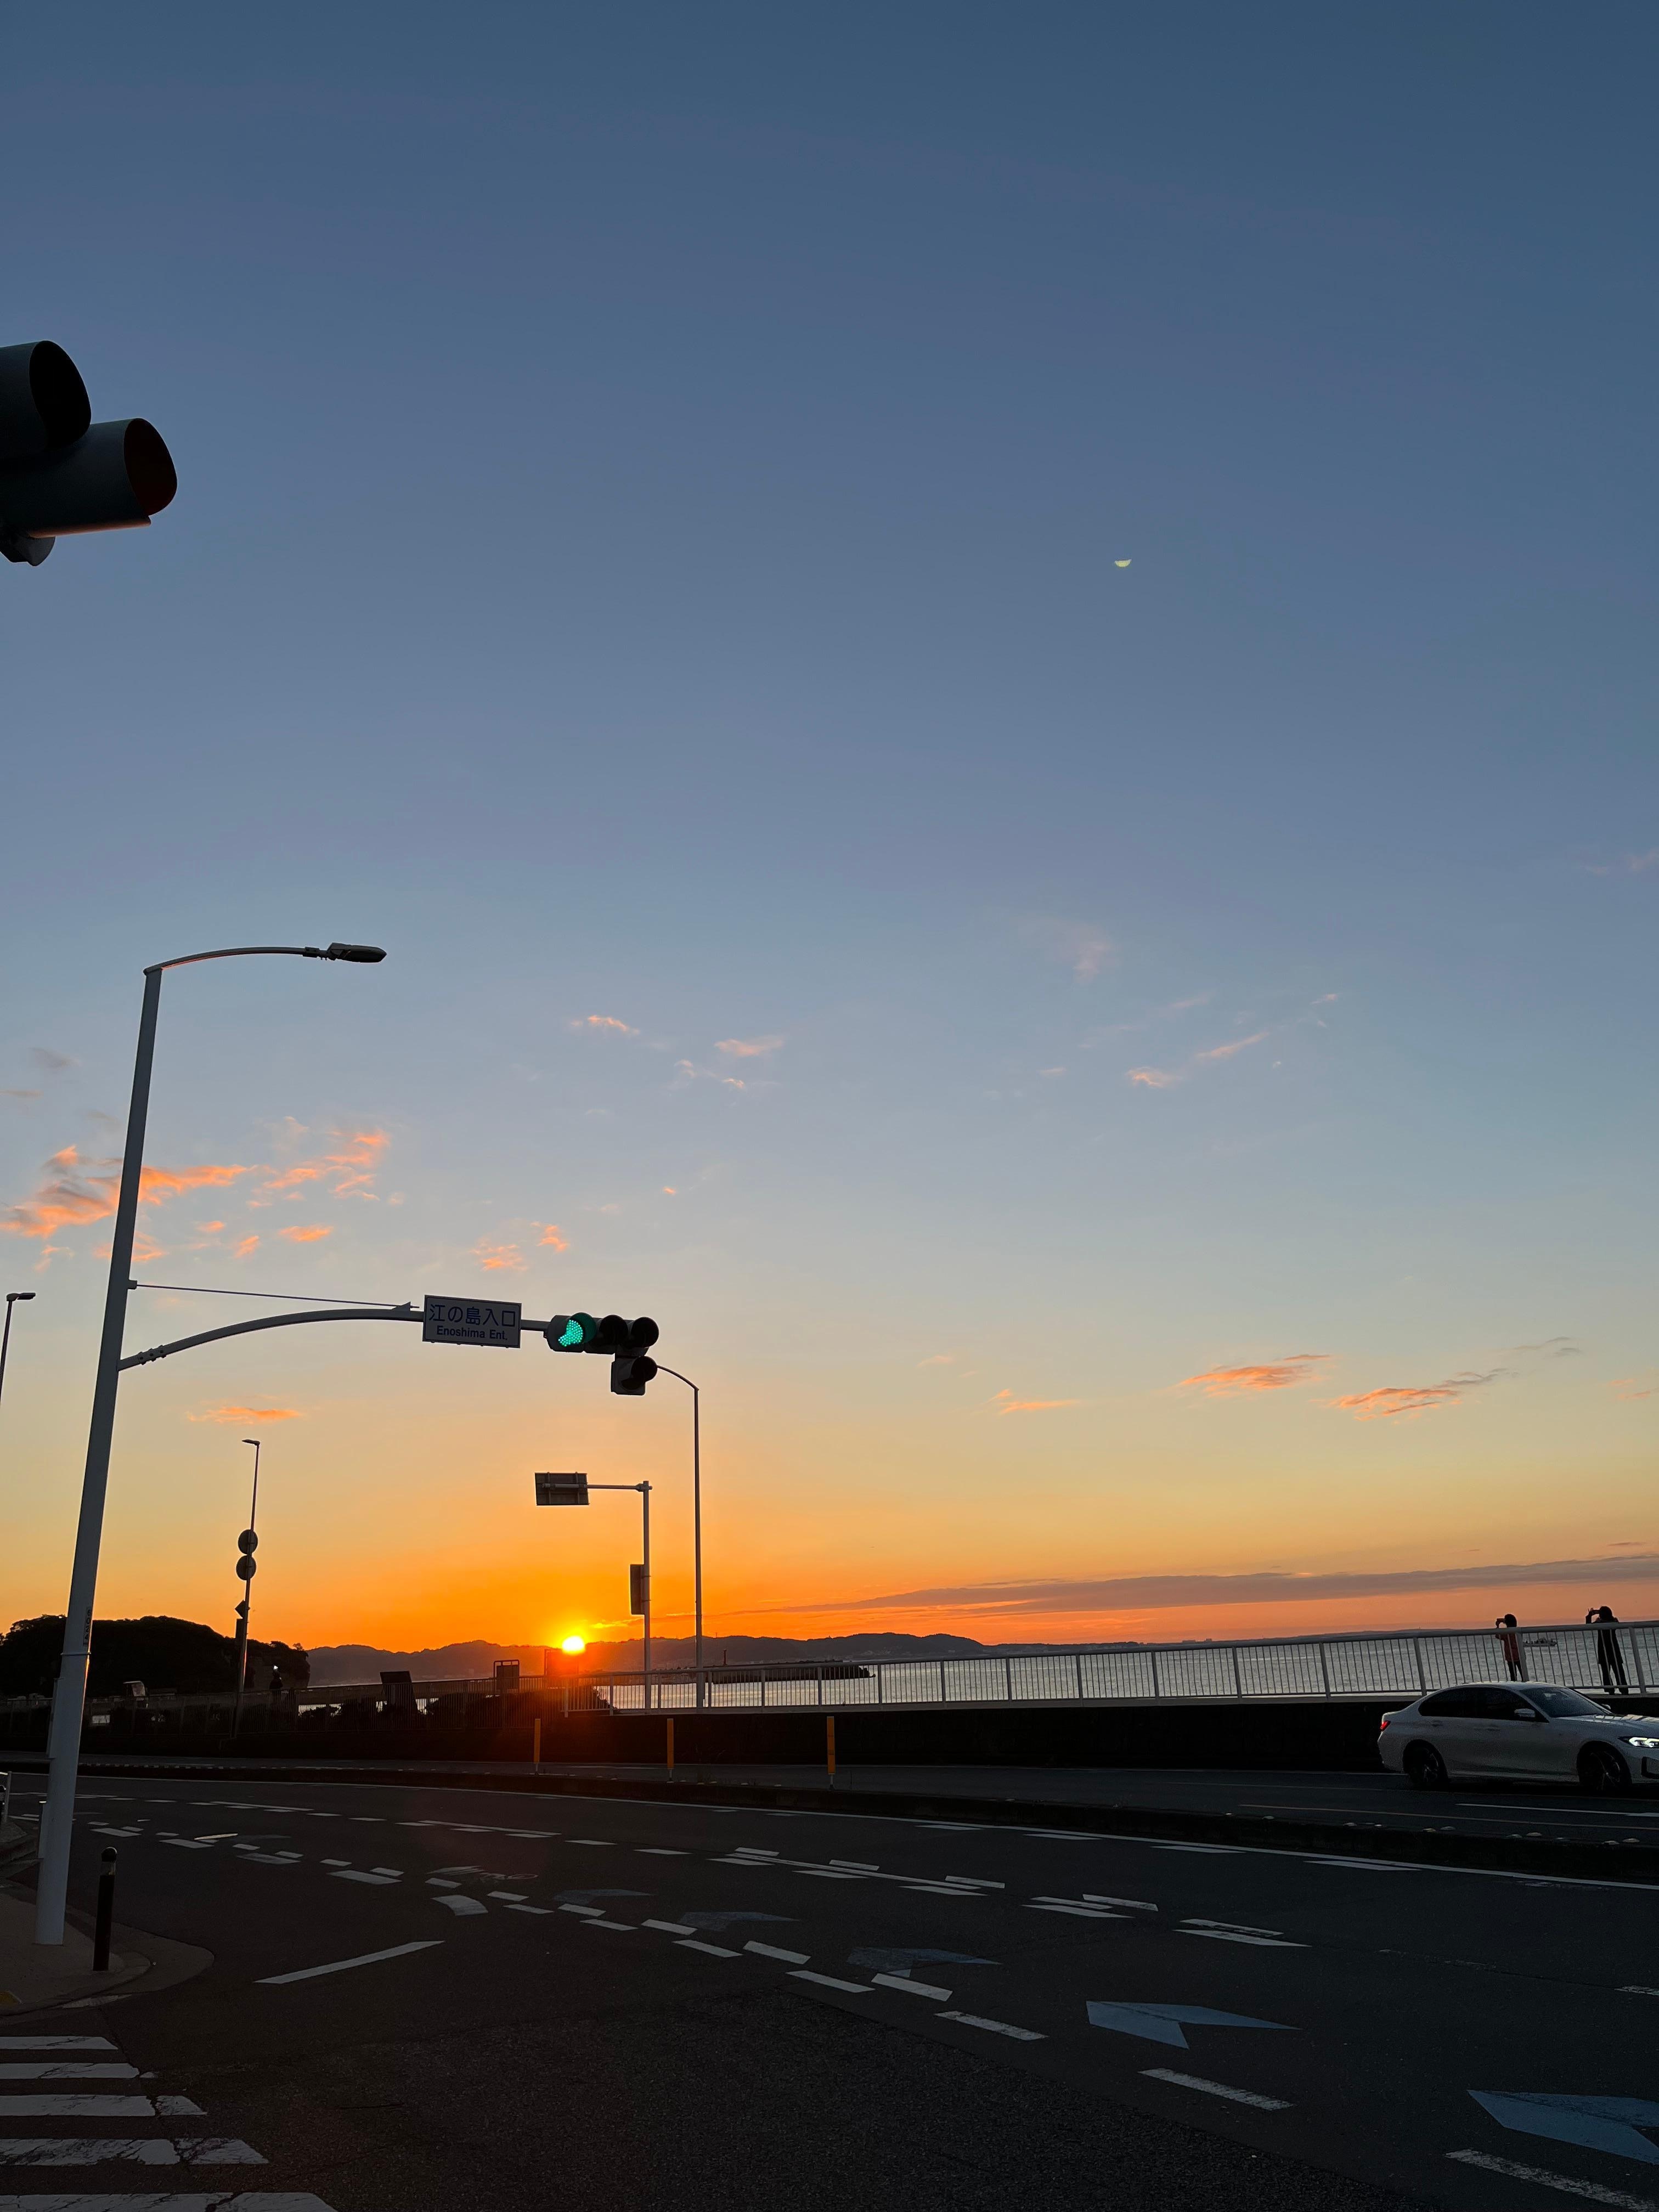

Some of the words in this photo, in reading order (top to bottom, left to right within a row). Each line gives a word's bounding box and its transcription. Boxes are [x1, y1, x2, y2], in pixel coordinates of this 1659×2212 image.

[429, 1304, 516, 1327] 江の島入口
[437, 1325, 485, 1338] Enoshima
[489, 1329, 508, 1340] Ent.
